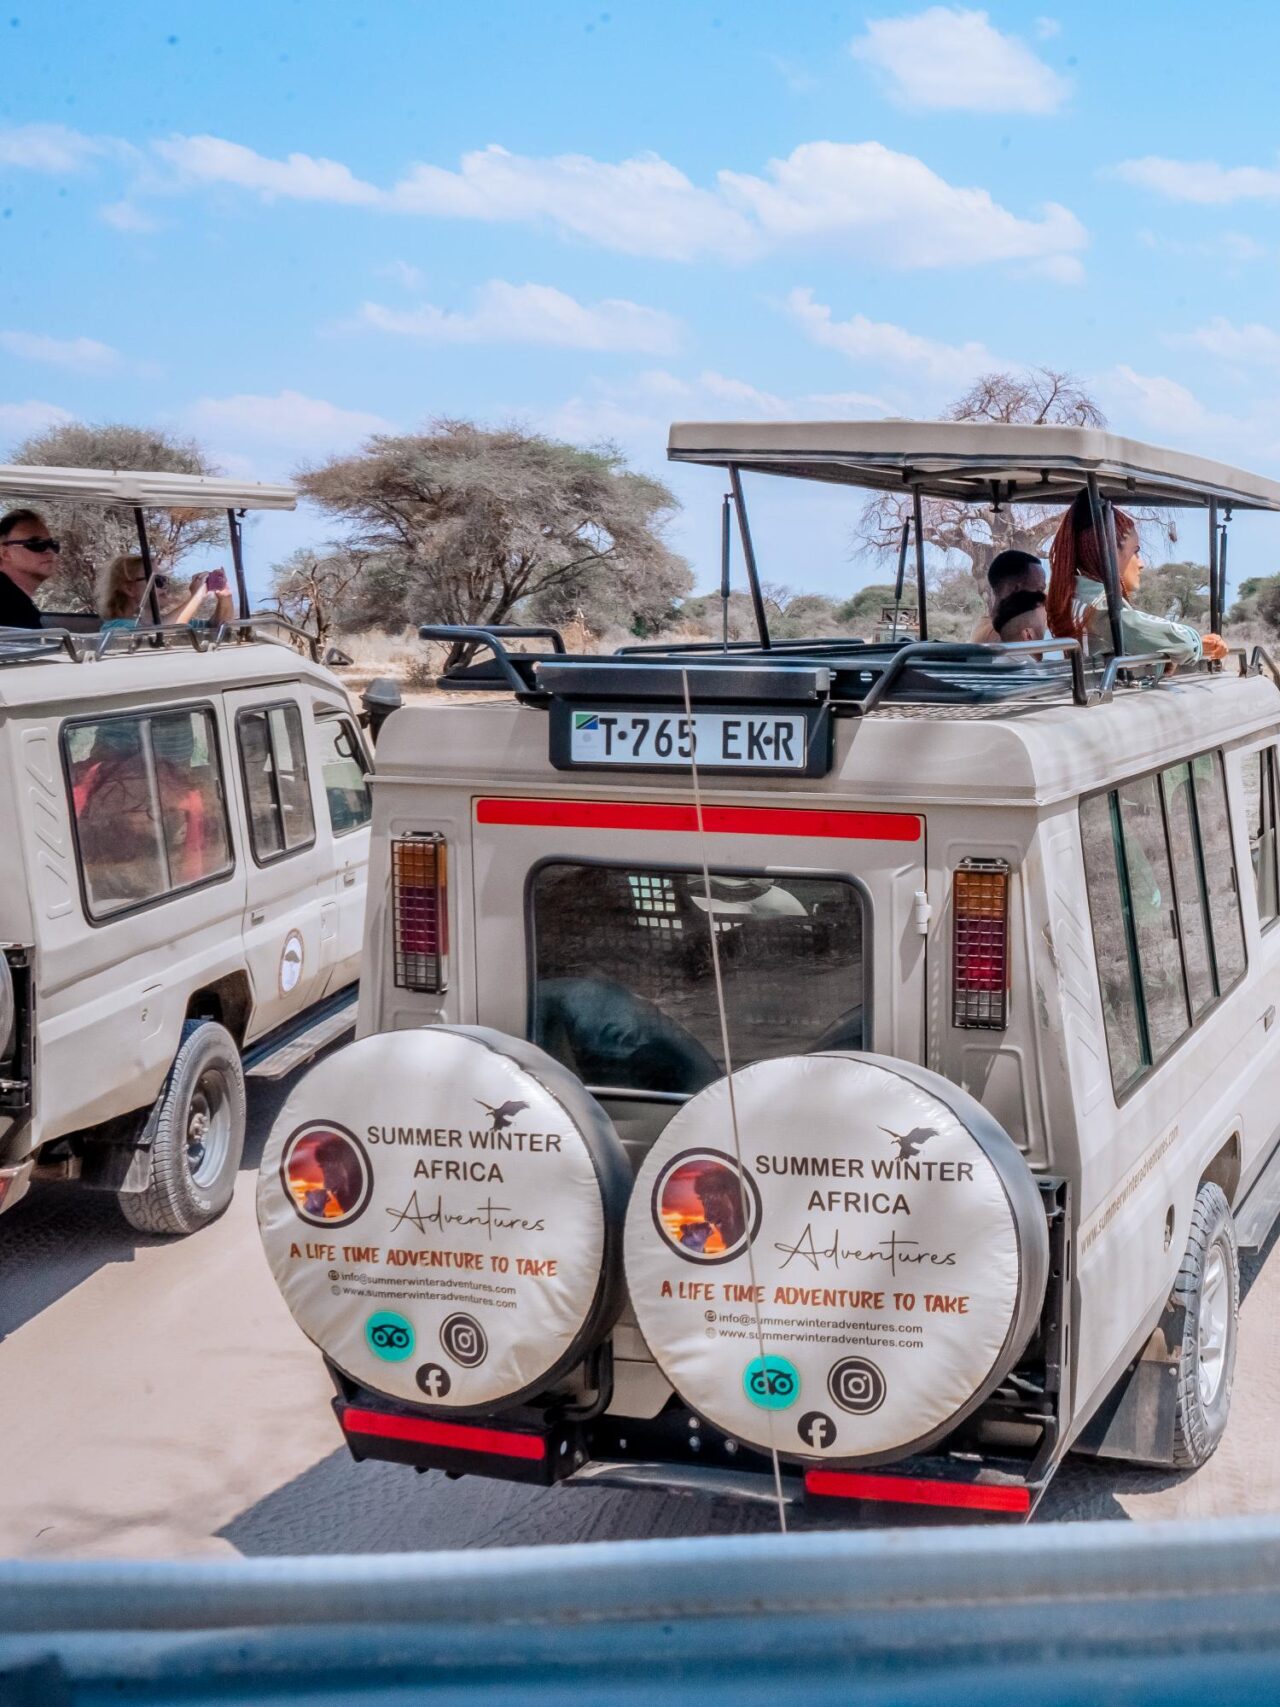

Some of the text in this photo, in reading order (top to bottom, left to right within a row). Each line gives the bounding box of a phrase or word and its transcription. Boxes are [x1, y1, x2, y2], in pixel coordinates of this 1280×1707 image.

[599, 718, 617, 756] T
[631, 718, 697, 757] 765
[367, 1126, 561, 1153] SUMMER WINTER
[413, 1159, 504, 1183] AFRICA
[755, 1155, 974, 1182] SUMMER WINTER
[385, 1190, 545, 1241] Adventures
[807, 1190, 911, 1215] AFRICA
[290, 1243, 558, 1277] A LIFE TIME ADVENTURE TO TAKE
[774, 1223, 957, 1277] Adventures
[341, 1272, 517, 1295] info@summerwinteradventures.com
[661, 1280, 970, 1314] A LIFE TIME ADVENTURE TO TAKE
[342, 1287, 518, 1309] www.summerwinteradventures.com
[719, 1329, 924, 1348] www.summerwinteradventures.com
